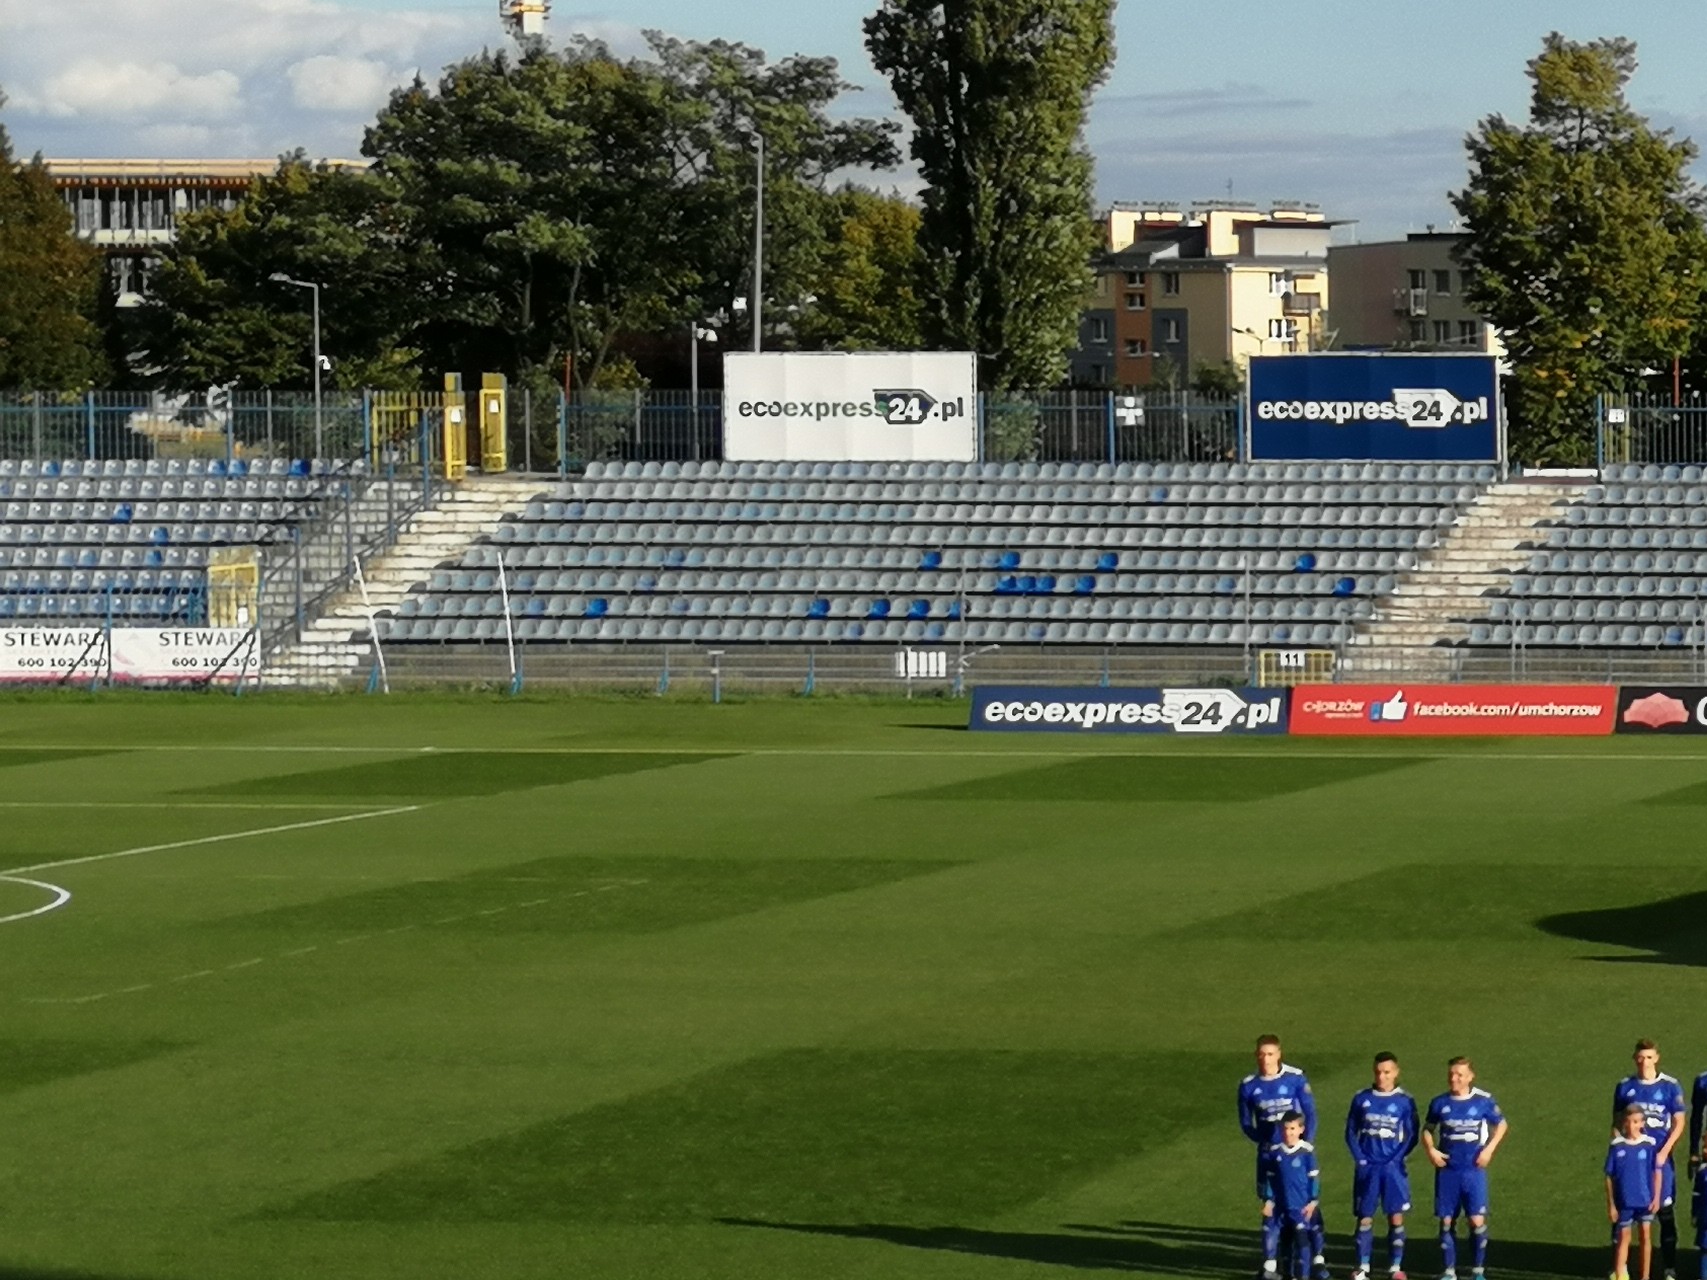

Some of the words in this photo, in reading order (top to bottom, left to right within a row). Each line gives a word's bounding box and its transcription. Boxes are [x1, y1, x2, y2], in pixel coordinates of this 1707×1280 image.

[738, 396, 964, 422] ecoexpress24.pl
[1257, 396, 1488, 424] ecoexpress24.pl
[4, 631, 104, 647] STEWAR
[159, 631, 255, 647] STEWAR
[17, 657, 45, 668] 600
[172, 657, 199, 668] 600
[1285, 652, 1299, 666] 11
[985, 696, 1281, 729] ecoexpress24.pl
[1412, 701, 1603, 718] facebook.com/umchorzow
